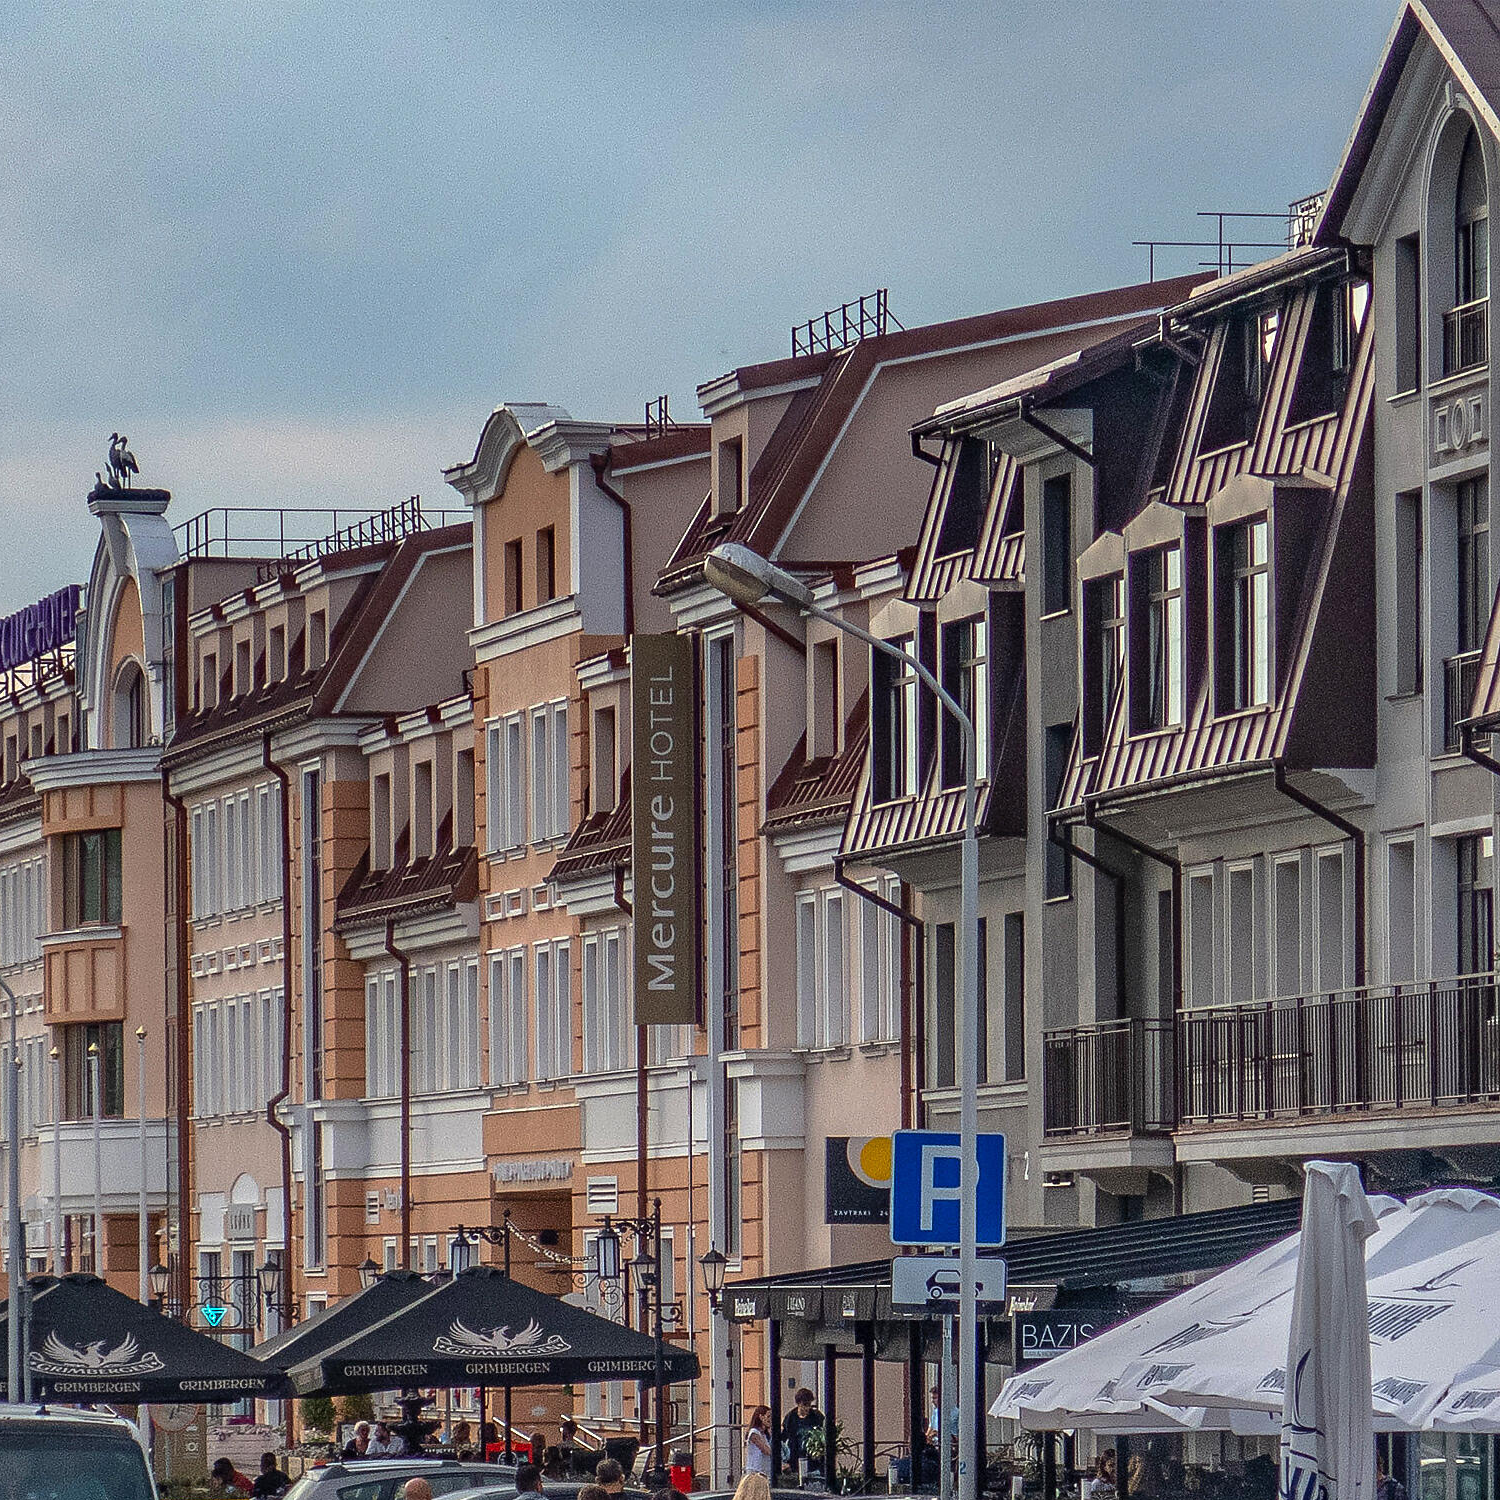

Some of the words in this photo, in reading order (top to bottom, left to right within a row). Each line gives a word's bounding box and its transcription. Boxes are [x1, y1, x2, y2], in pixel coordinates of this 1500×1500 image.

[650, 665, 674, 781] HOTEL
[647, 794, 675, 992] Mercure
[920, 1144, 980, 1231] P
[1022, 1323, 1094, 1349] BAZIS
[453, 1342, 561, 1357] GRIMBERGEN
[37, 1362, 155, 1376] GRIMBERGEN
[344, 1364, 429, 1377] GRIMBERGEN
[465, 1361, 551, 1375] GRIMBERGEN
[587, 1359, 673, 1373] GRIMBERGN
[53, 1381, 142, 1394] GRIMBERGEN
[179, 1378, 267, 1392] GRIMBERGEN
